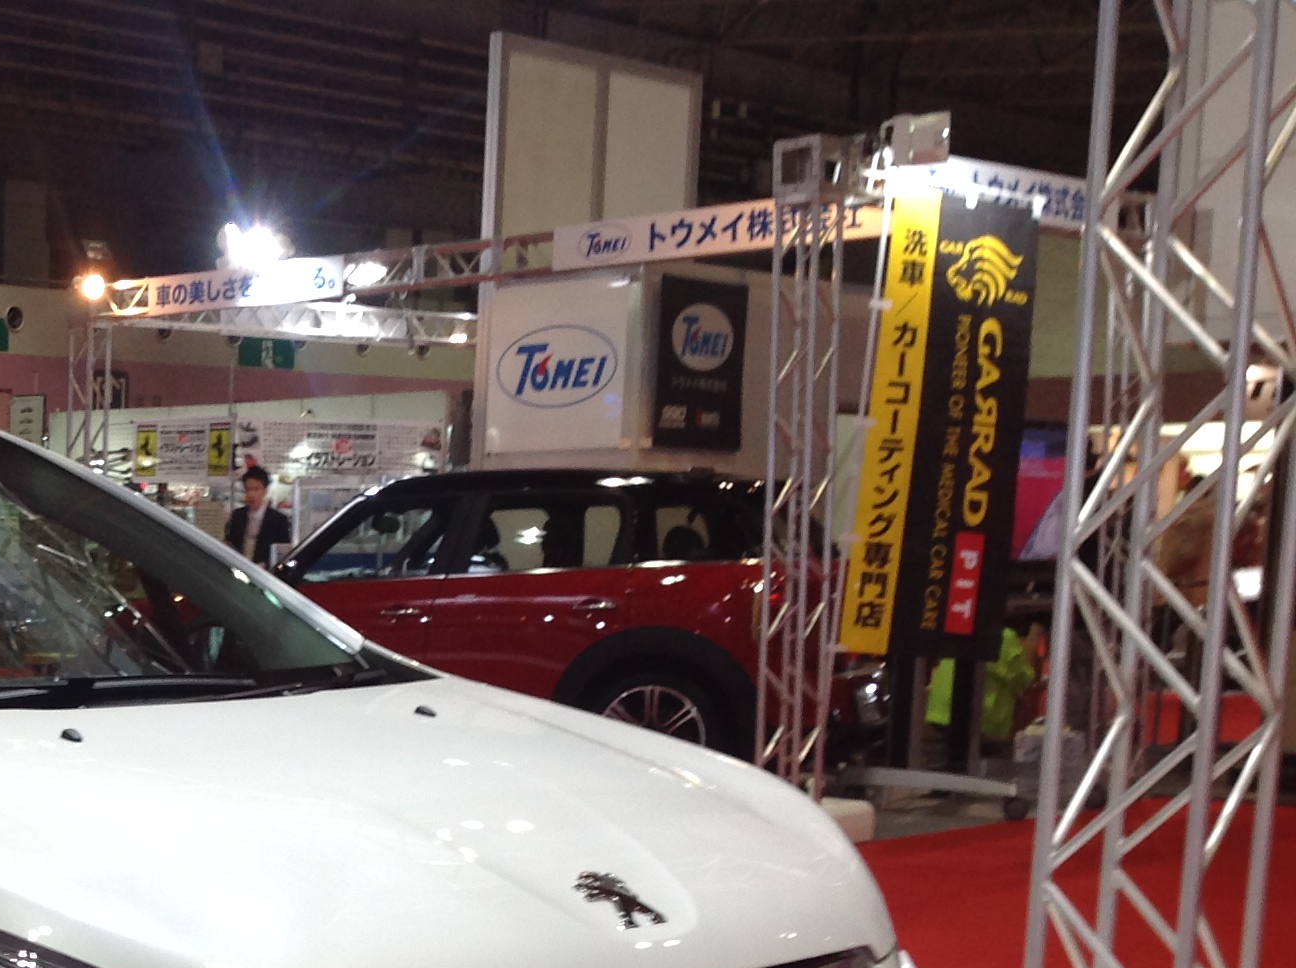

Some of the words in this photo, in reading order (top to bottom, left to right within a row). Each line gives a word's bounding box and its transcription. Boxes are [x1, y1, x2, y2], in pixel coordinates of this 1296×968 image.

[584, 231, 628, 257] TOMEI
[680, 316, 729, 361] TOMEI
[951, 314, 972, 390] PIONEER
[514, 343, 608, 397] TOMEI
[947, 394, 965, 420] OF
[942, 425, 962, 457] THE
[932, 462, 956, 539] MEDICAL
[928, 544, 948, 580] CAR
[951, 549, 979, 619] PIT
[920, 585, 943, 631] CARE
